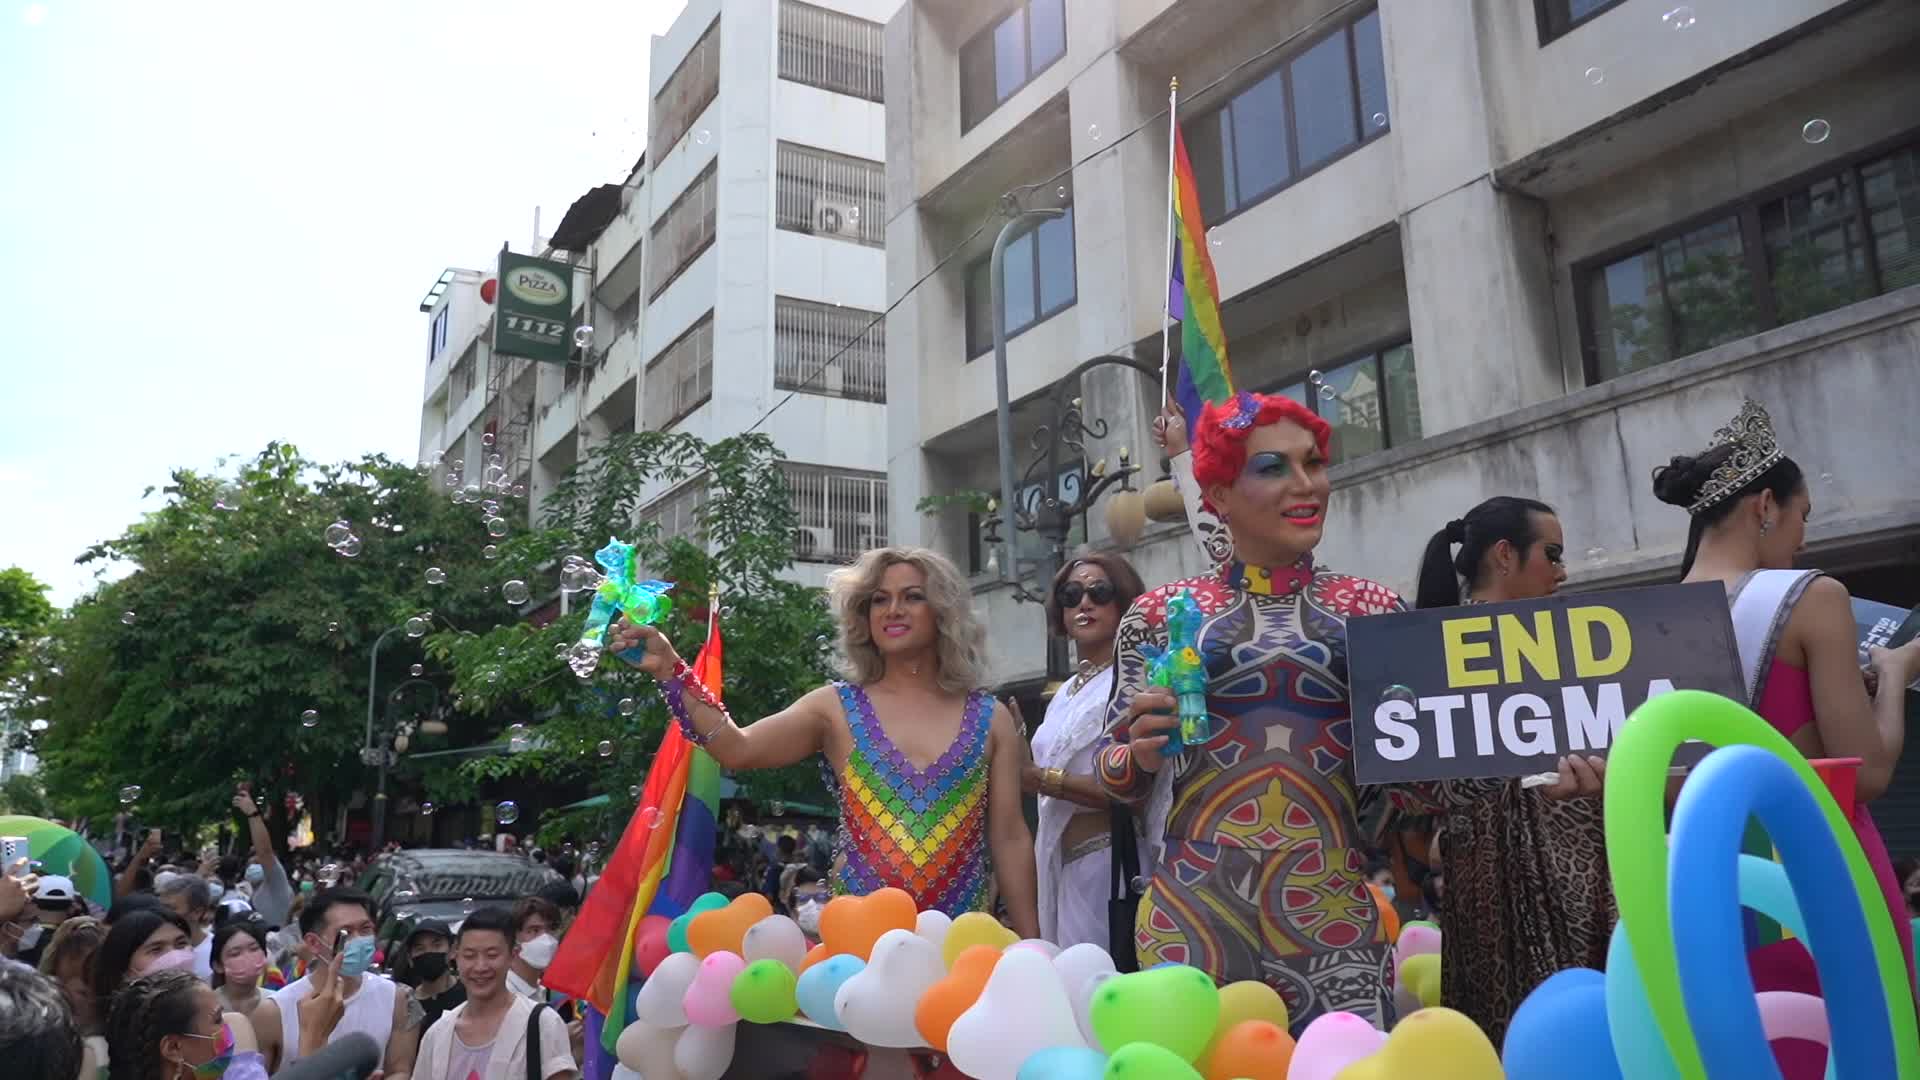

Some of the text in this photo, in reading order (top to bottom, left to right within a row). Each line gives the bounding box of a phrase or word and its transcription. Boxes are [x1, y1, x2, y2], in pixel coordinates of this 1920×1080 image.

[519, 274, 558, 293] PIZZA
[505, 317, 566, 337] 1112
[1441, 605, 1633, 688] END
[1374, 678, 1706, 761] STIGM
